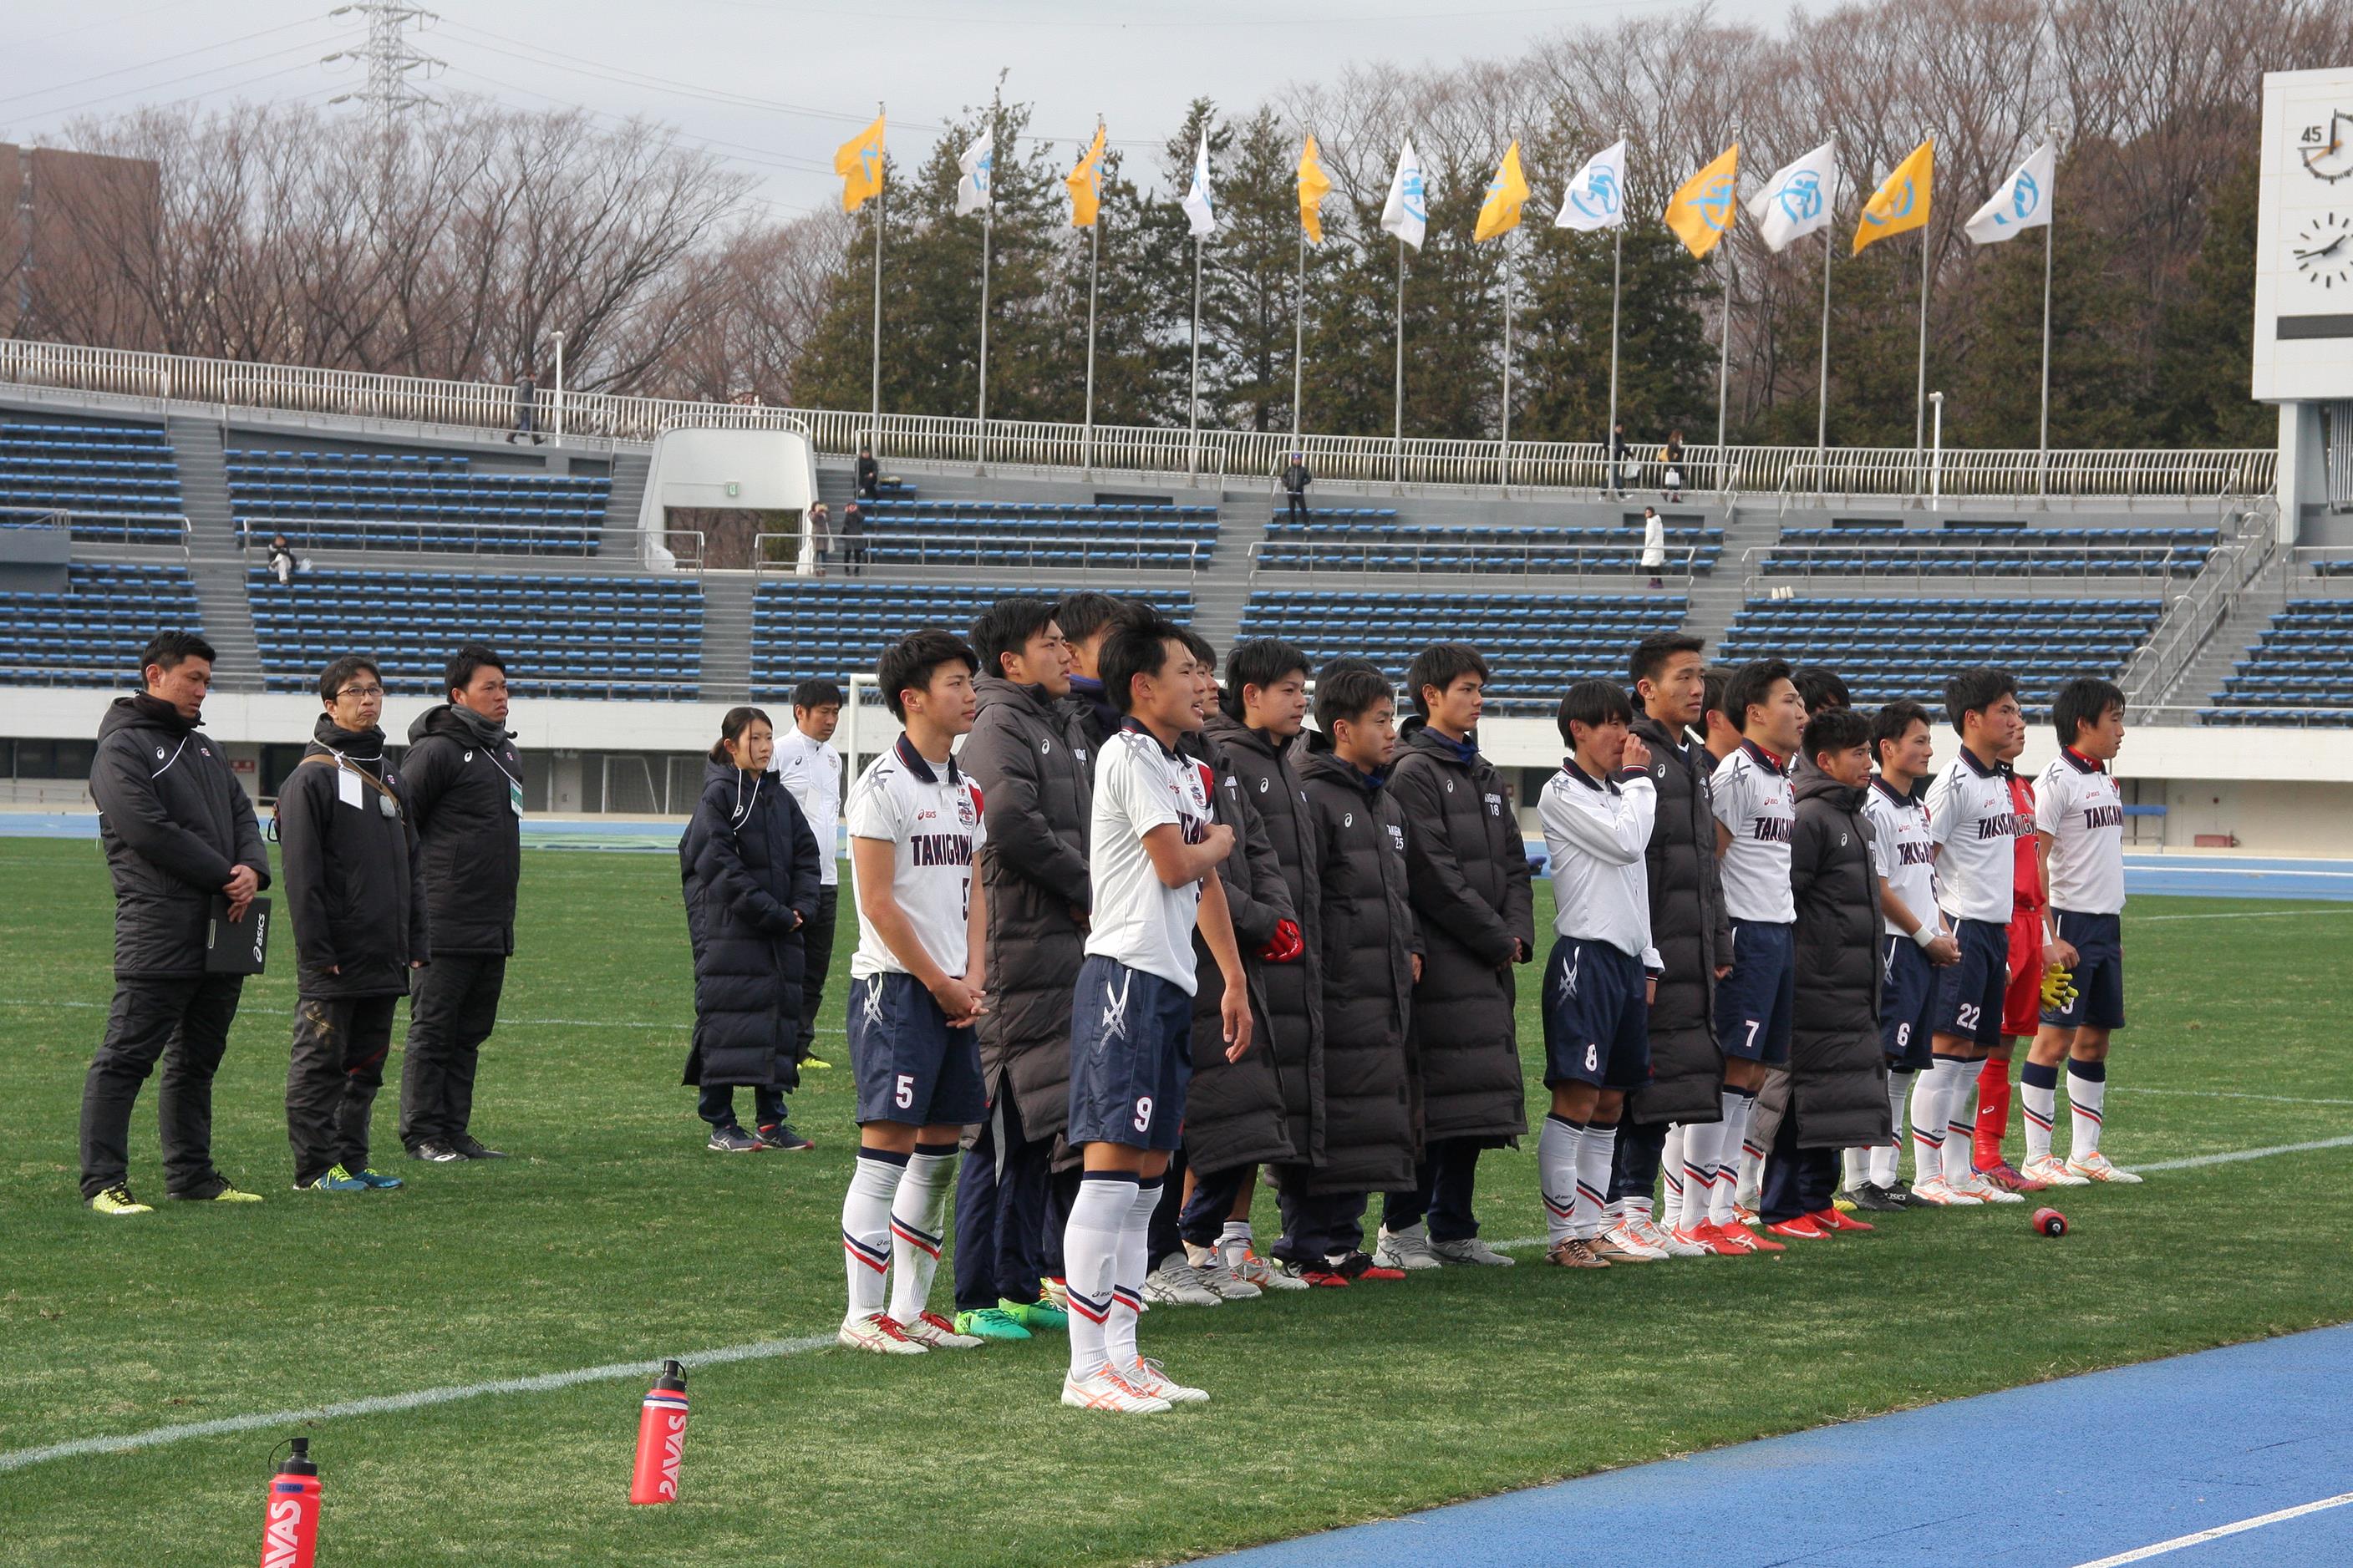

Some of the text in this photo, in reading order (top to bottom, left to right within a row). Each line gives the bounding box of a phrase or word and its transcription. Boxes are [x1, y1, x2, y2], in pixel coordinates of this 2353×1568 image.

[2301, 126, 2321, 142] 45
[1490, 804, 1500, 816] 18
[1395, 837, 1404, 850] 25
[1956, 1002, 1980, 1030] 22
[1746, 1020, 1760, 1047] 7
[1897, 1022, 1910, 1047] 6
[1585, 1044, 1597, 1072] 8
[896, 1074, 914, 1109] 5
[1134, 1097, 1153, 1133] 9
[659, 1415, 687, 1499] SAVAS
[264, 1499, 302, 1568] AVAS
